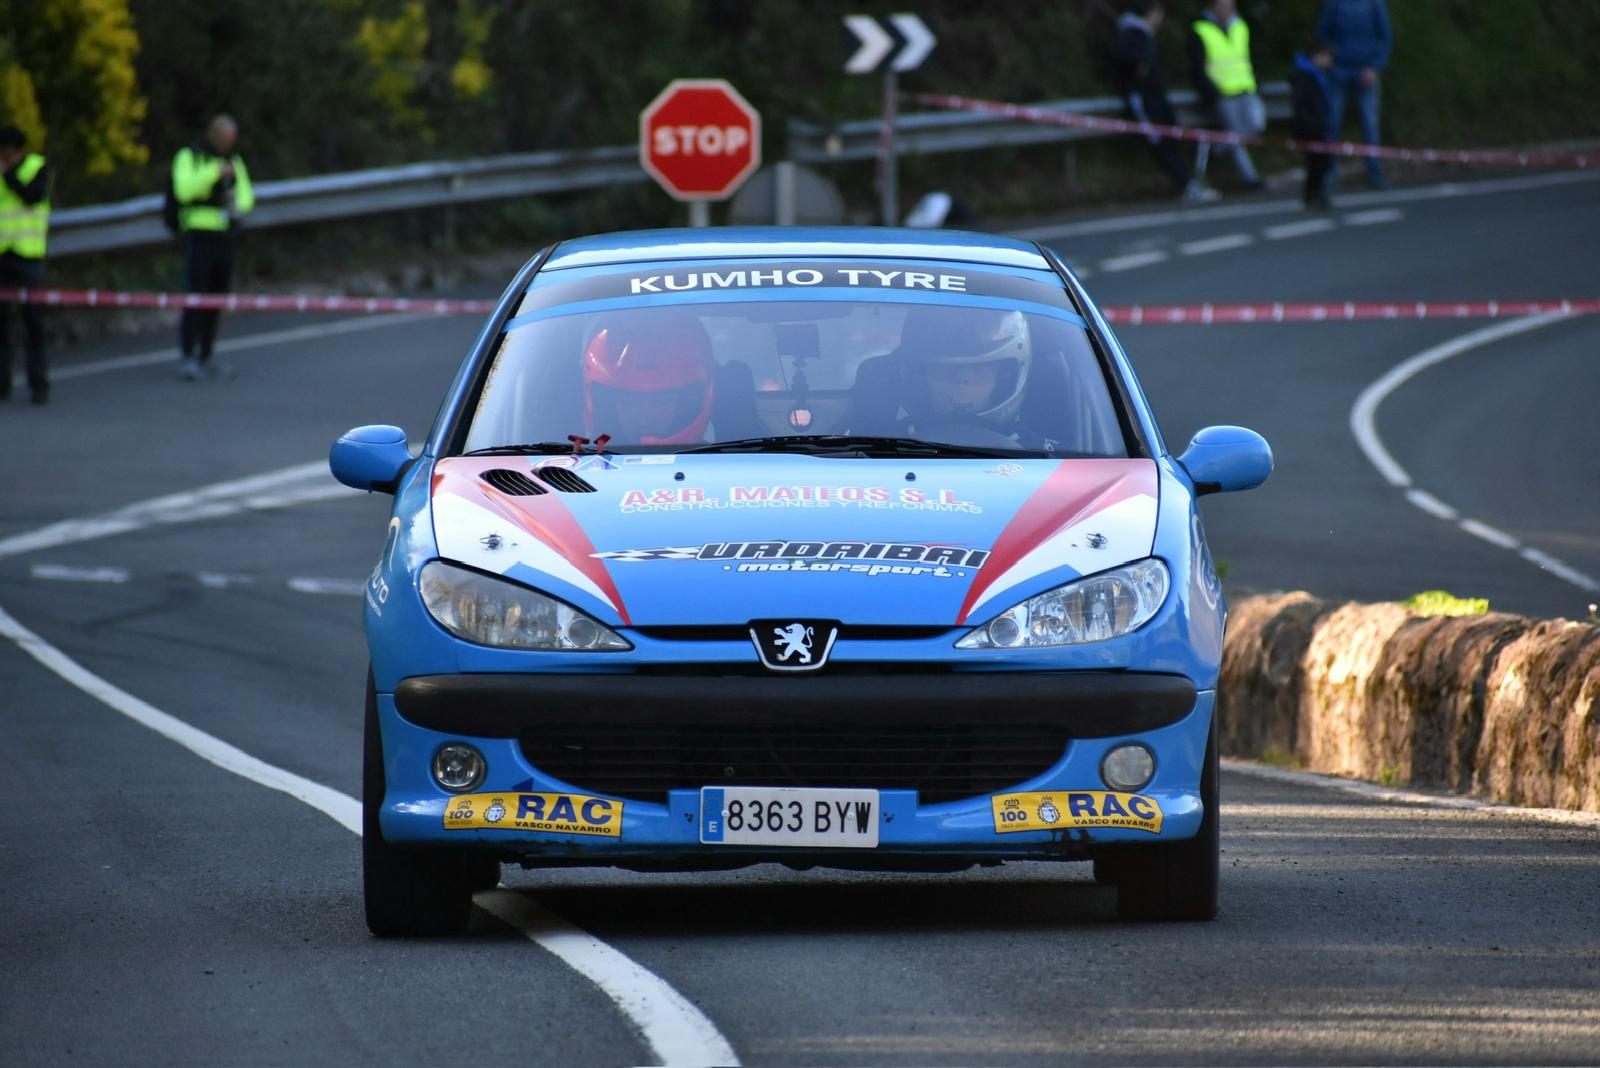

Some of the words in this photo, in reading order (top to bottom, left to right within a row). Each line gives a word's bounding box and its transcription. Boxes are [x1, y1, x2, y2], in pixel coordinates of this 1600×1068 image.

[653, 125, 748, 156] STOP
[630, 269, 824, 294] KUMHO
[837, 269, 966, 292] TYRE
[730, 486, 891, 502] MATEOS
[620, 499, 829, 514] CONSTRUCCIONES
[838, 500, 849, 508] Y
[858, 500, 983, 514] REFORMAS
[697, 541, 991, 569] URDAIBAI
[515, 794, 612, 825] RAC
[1068, 793, 1157, 820] RAC
[449, 810, 473, 820] 100
[727, 800, 803, 832] 8363
[814, 801, 871, 833] BYW
[1000, 810, 1027, 822] 100
[514, 821, 553, 830] VASCO
[556, 824, 611, 833] NAVARRO
[708, 821, 718, 833] E
[1112, 819, 1155, 830] NAVARRO
